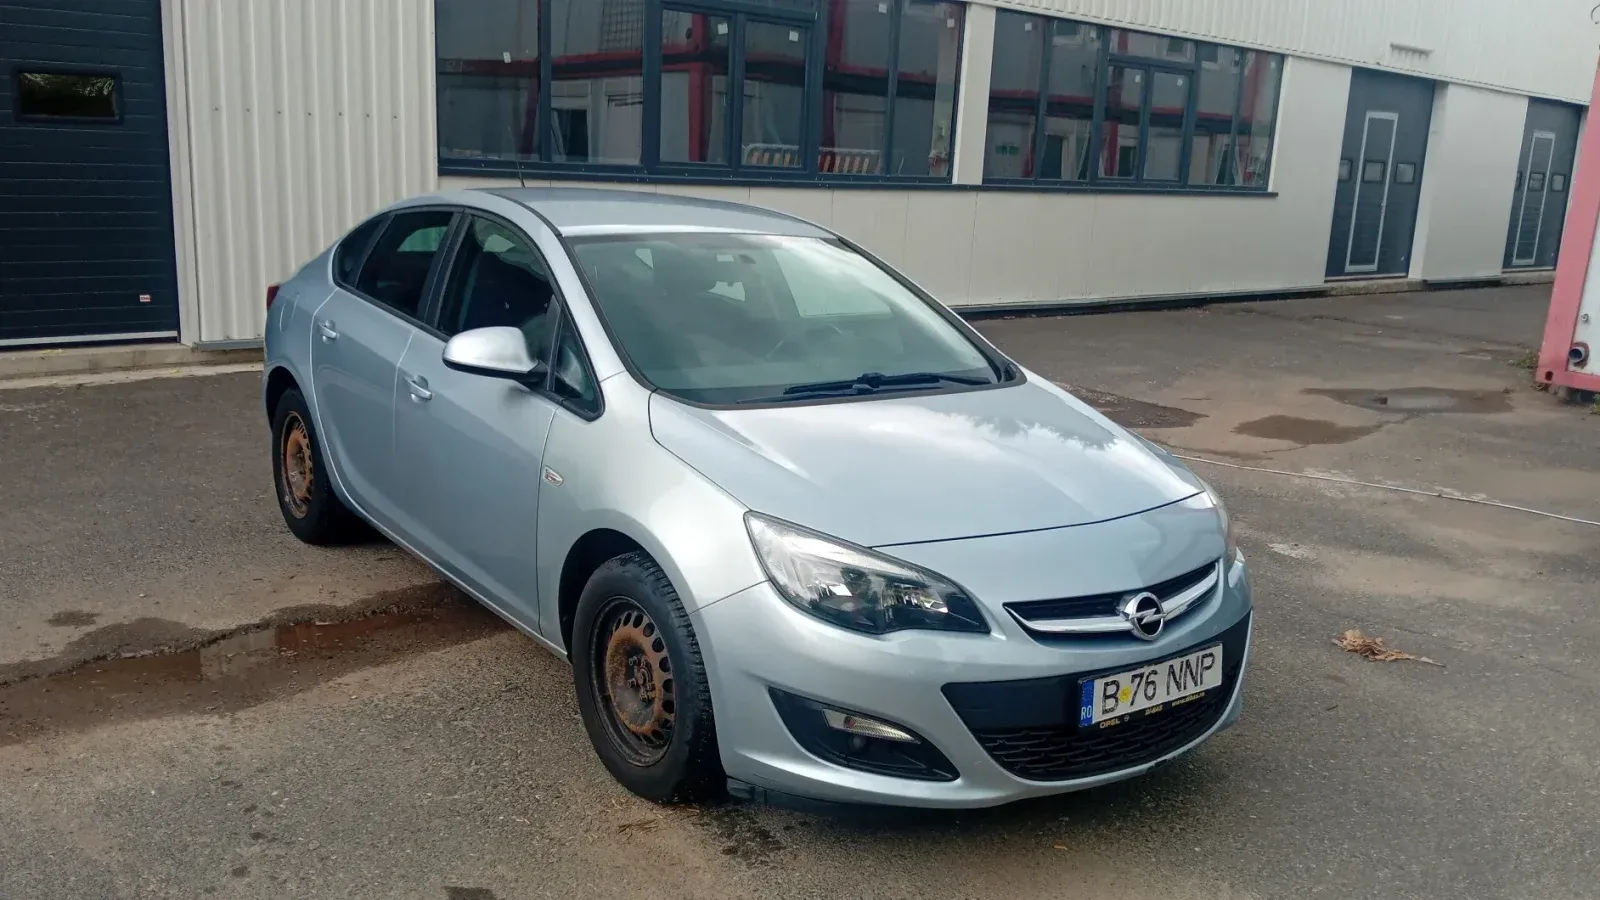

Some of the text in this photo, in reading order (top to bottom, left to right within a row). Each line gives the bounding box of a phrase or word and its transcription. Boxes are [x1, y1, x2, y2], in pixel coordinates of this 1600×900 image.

[1102, 653, 1215, 715] B 76 NNP
[1081, 705, 1092, 720] RO
[1100, 718, 1120, 729] OPEL
